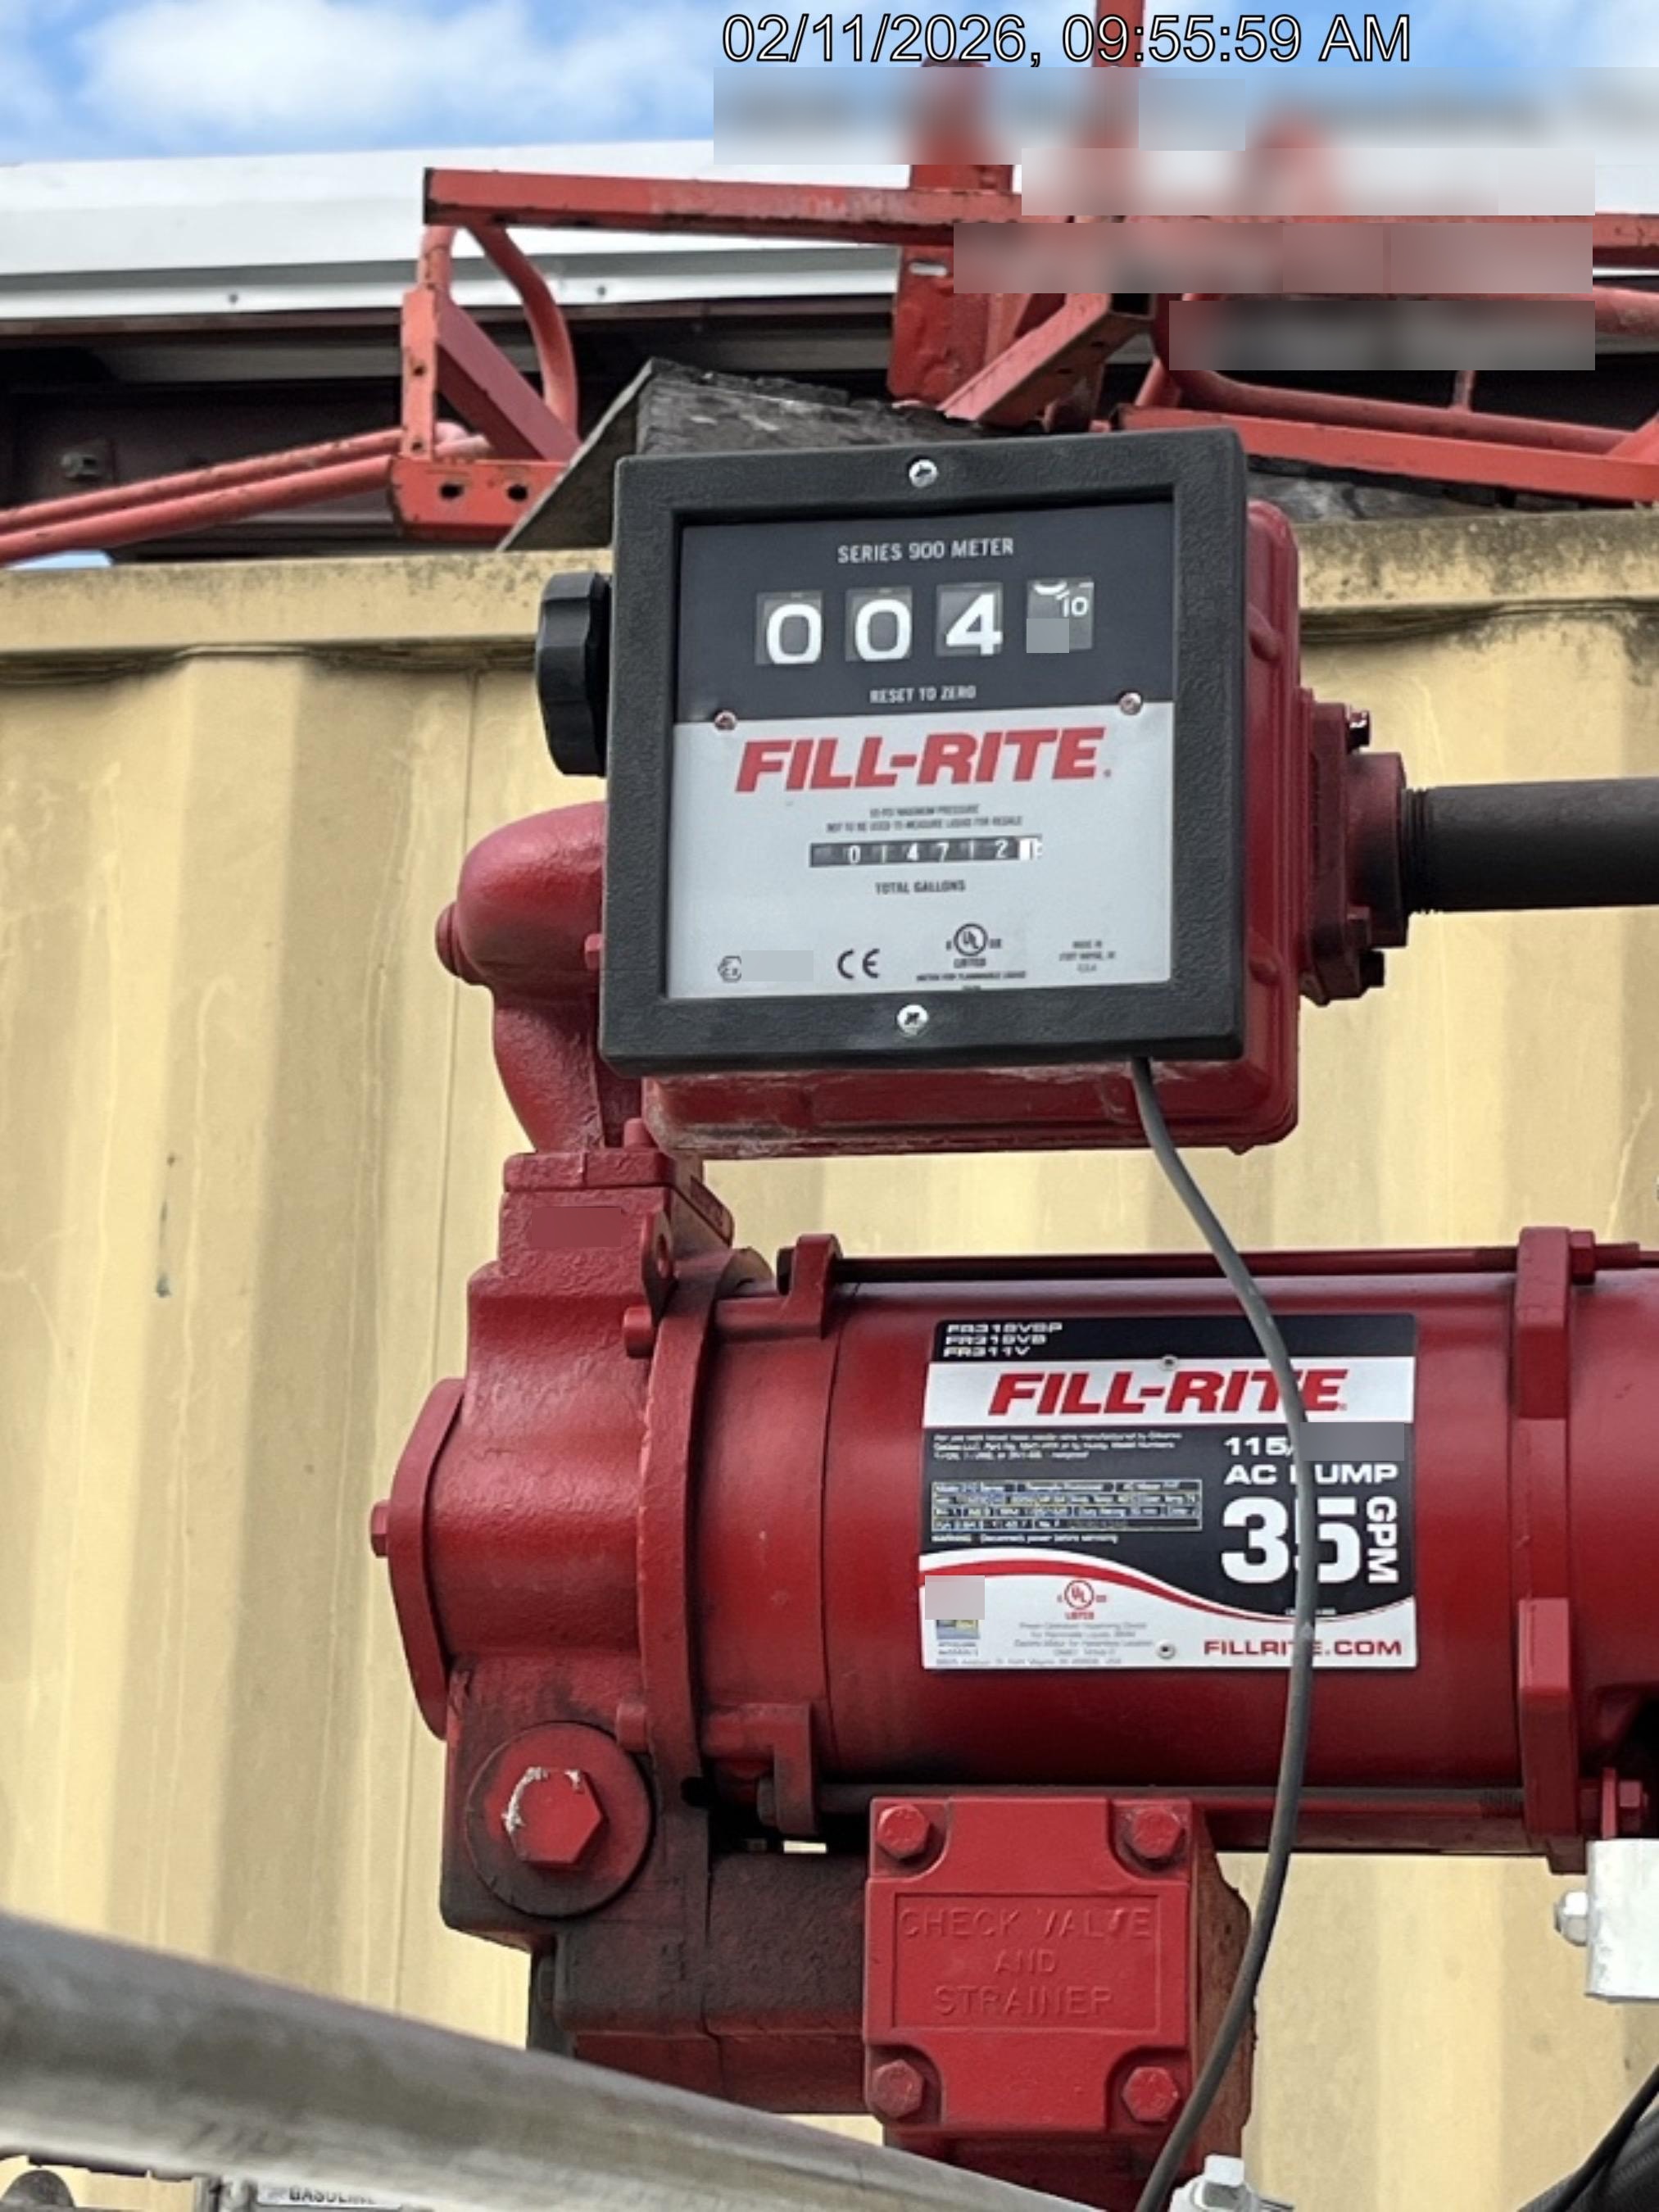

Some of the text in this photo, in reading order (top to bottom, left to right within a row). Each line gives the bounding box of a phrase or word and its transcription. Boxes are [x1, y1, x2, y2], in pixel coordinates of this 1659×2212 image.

[837, 537, 1013, 564] SERIES 900 METER
[869, 685, 977, 704] RESET TO ZERO
[735, 727, 1106, 792] FILL-RITE
[874, 879, 966, 895] TOTAL GALLONS
[1224, 1464, 1398, 1485] AC UMP
[1221, 1497, 1361, 1584] 35
[1367, 1496, 1398, 1584] GPM
[1204, 1640, 1402, 1656] FILLRIE.COM
[900, 1906, 1152, 1939] CHECK VALVE
[994, 1949, 1057, 1974] AND
[935, 1984, 1113, 2017] STRAINER
